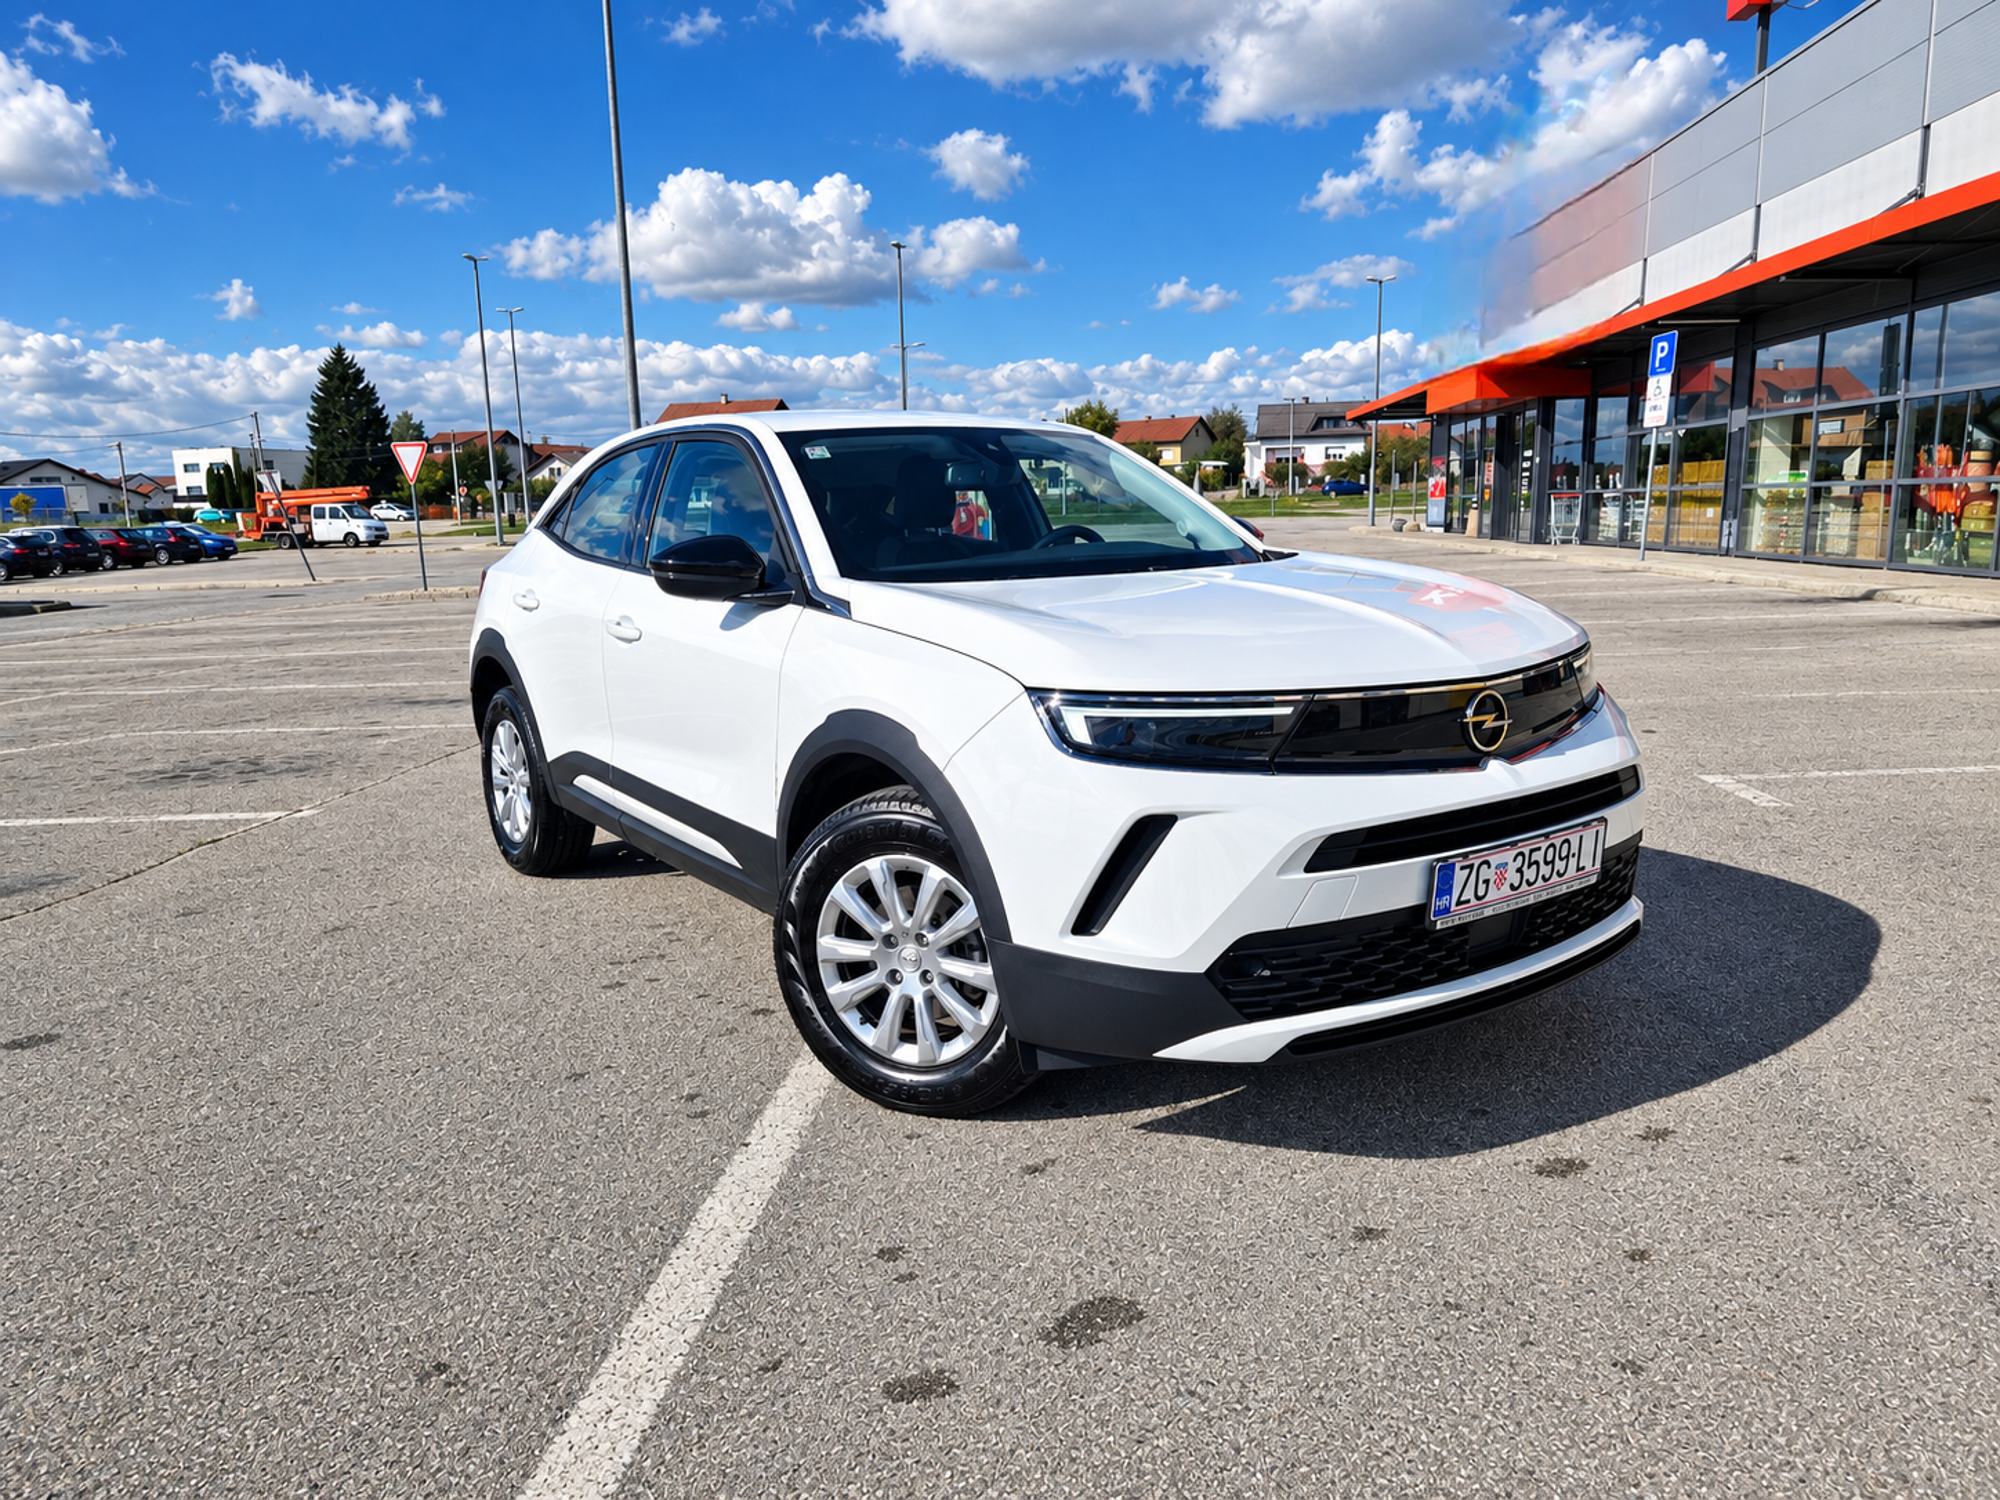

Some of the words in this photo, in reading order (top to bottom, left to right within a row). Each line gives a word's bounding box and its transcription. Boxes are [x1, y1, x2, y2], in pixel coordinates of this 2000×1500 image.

[1655, 341, 1669, 368] P
[1455, 859, 1491, 907] ZG
[1435, 894, 1450, 911] HR
